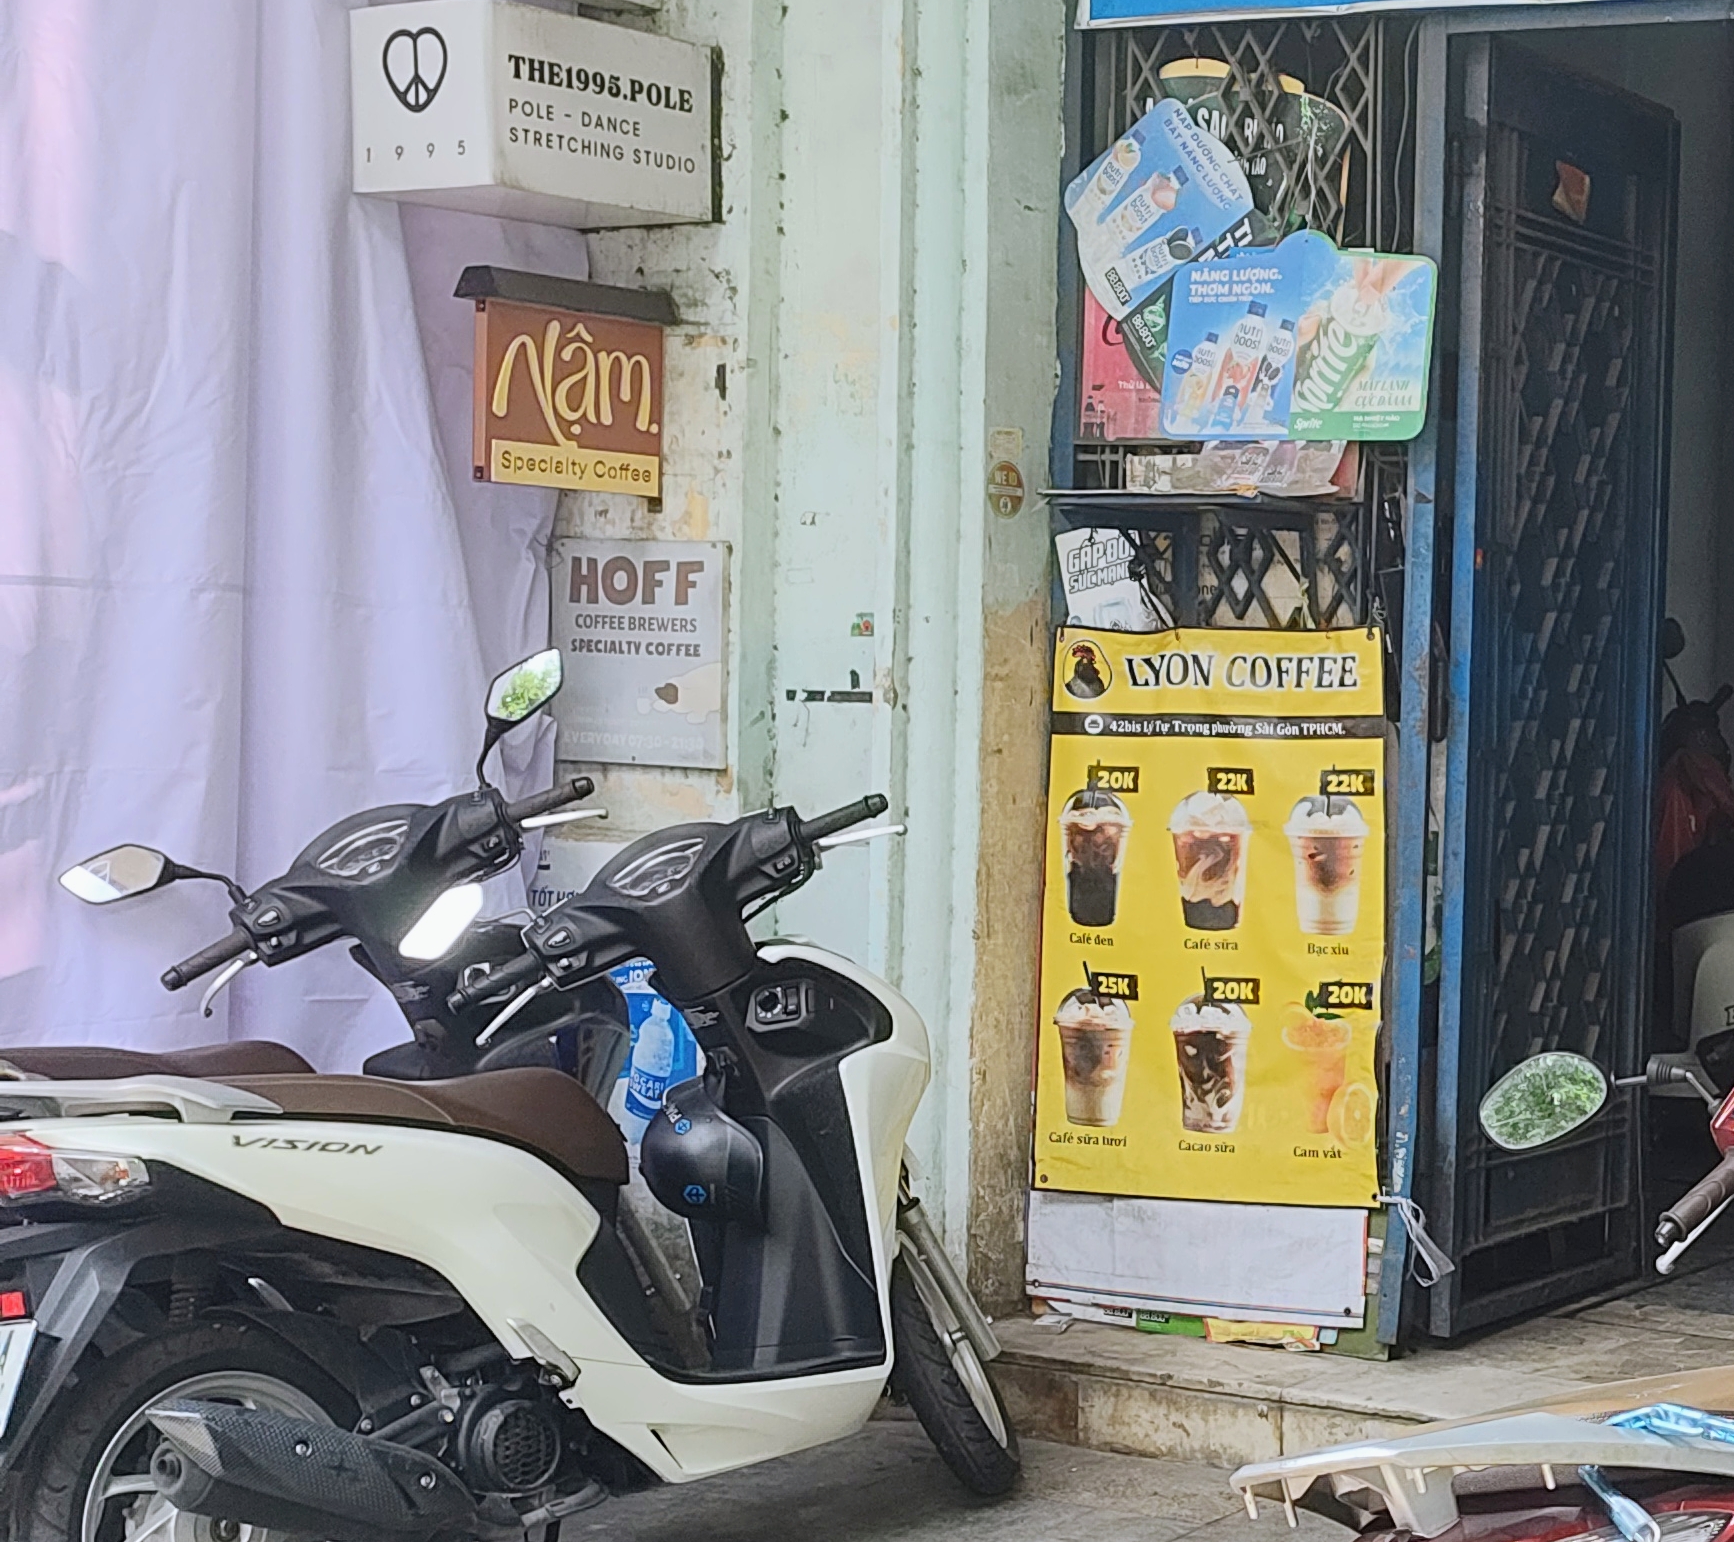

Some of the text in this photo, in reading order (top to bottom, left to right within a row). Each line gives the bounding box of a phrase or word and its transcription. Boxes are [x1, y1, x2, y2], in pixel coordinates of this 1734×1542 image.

[507, 53, 694, 115] THE1995.POLE
[508, 97, 556, 123] POLE
[580, 109, 642, 138] DANCE
[508, 126, 697, 175] STRETCHING STUDIO
[1190, 267, 1230, 283] NĂNG
[1293, 417, 1324, 431] Sprite
[500, 449, 653, 485] Specialty Coffee
[568, 554, 705, 607] HOFF
[574, 613, 698, 635] COFFEE BREWERS
[569, 637, 702, 659] SPECIALTY COFFEE
[1124, 652, 1359, 691] LYON COFFEE
[1109, 719, 1142, 733] 42bis
[1143, 719, 1155, 736] Lý
[1171, 720, 1210, 736] Trọng
[1211, 720, 1253, 737] phường
[1254, 721, 1274, 735] Sài
[1276, 722, 1300, 736] Gòn
[1301, 722, 1347, 736] TPHCM.
[1097, 770, 1135, 789] 20K
[1216, 771, 1249, 792] 22K
[1326, 774, 1365, 794] 22K
[1069, 932, 1093, 946] Café
[1184, 938, 1239, 952] Café sữa
[1307, 942, 1330, 958] Bạc
[1097, 975, 1130, 996] 25K
[1212, 981, 1255, 1002] 20K
[1326, 985, 1367, 1006] 20K
[231, 1133, 384, 1158] VISION
[1048, 1131, 1074, 1145] Café
[1076, 1133, 1100, 1146] sữa
[1178, 1140, 1236, 1155] Cacao sữa
[1293, 1144, 1342, 1160] Cam vắt
